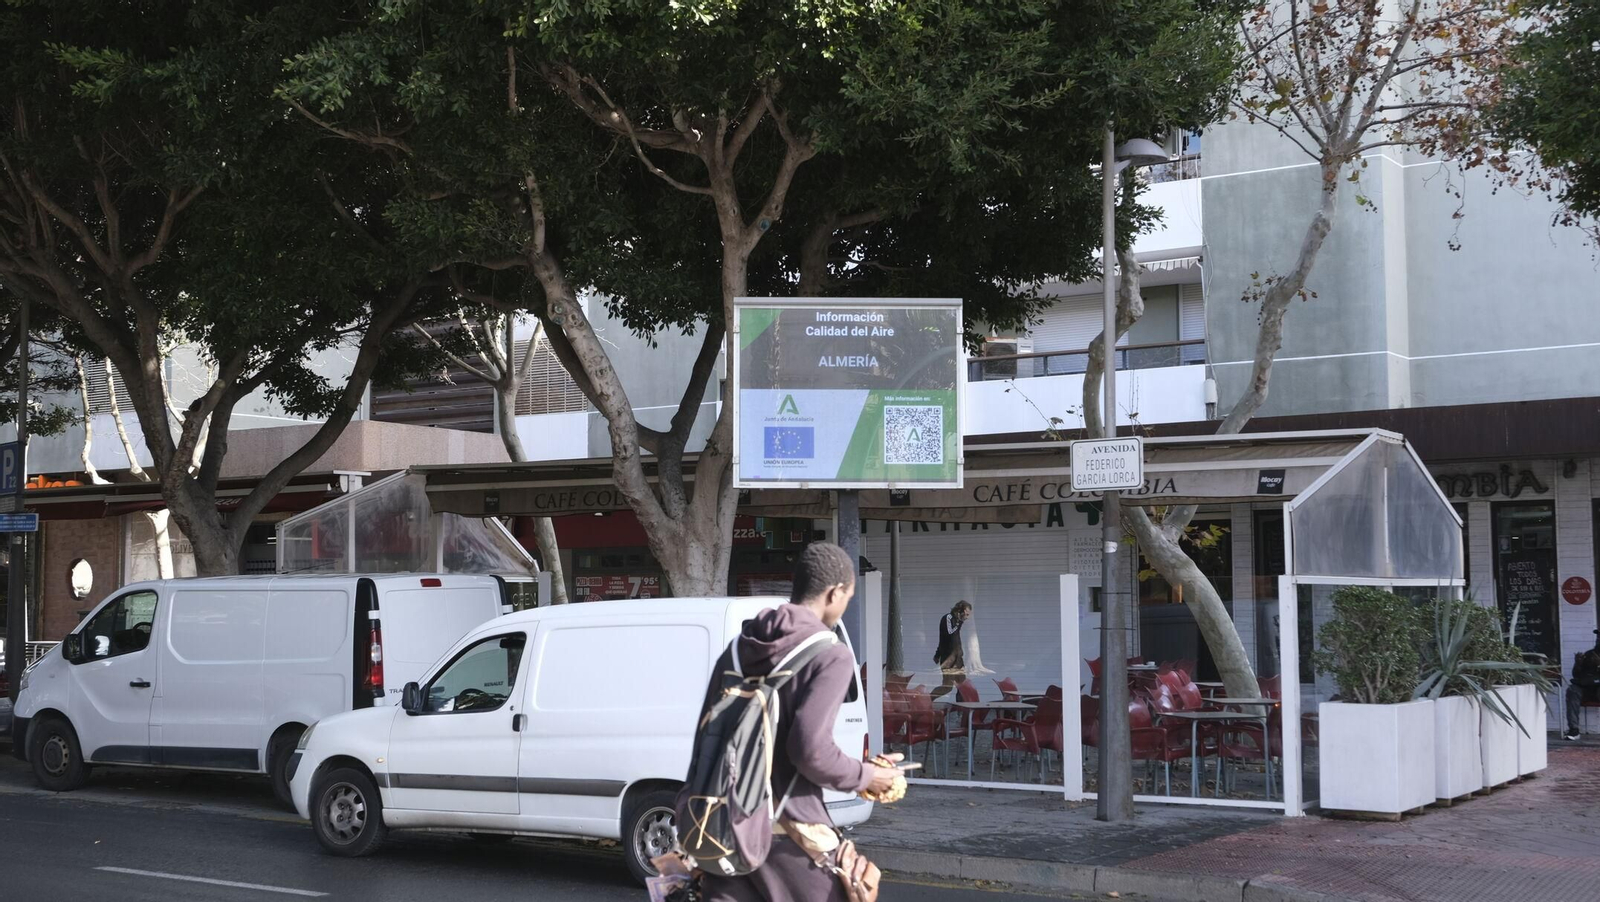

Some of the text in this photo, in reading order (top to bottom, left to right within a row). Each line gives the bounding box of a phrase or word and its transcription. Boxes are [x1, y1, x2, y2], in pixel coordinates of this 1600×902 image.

[816, 311, 884, 323] Información
[806, 326, 894, 337] Calidad del Aire
[818, 355, 879, 368] ALMERÍA
[1091, 444, 1136, 454] AVENIDA
[2, 448, 15, 490] P
[1085, 458, 1126, 471] FEDERICO
[8, 476, 17, 488] 22
[1076, 471, 1136, 486] GARCÍA LORCA
[972, 476, 1180, 503] CAFÉ COBIA
[1509, 577, 1522, 585] LOS
